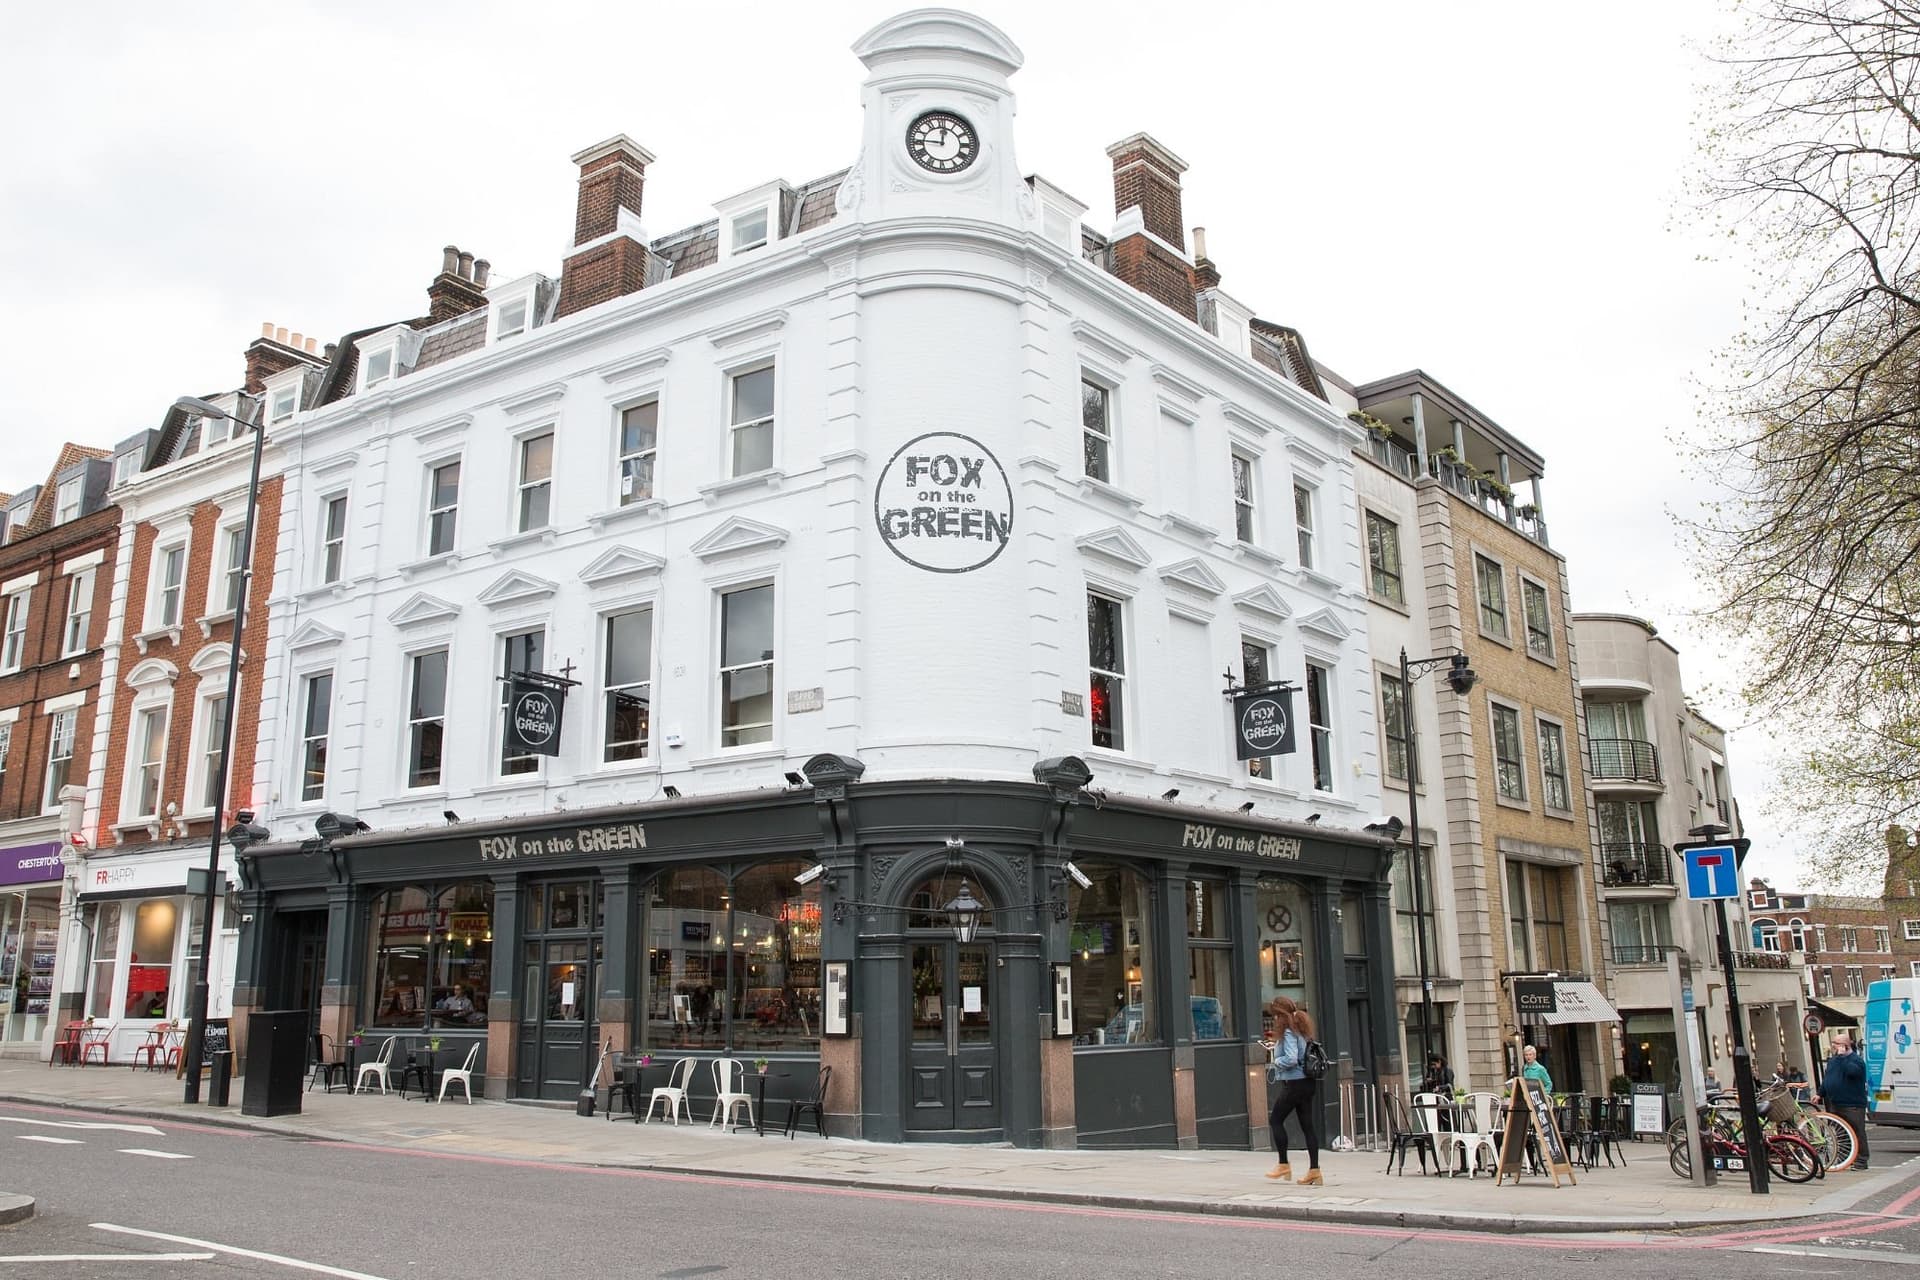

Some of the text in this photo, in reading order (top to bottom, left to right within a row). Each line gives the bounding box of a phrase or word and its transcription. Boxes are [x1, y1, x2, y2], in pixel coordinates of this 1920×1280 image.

[906, 455, 984, 488] FOX
[918, 491, 976, 503] on the
[882, 507, 1009, 544] GREEN
[525, 699, 548, 714] FOX
[1250, 707, 1275, 721] FOX
[518, 717, 553, 735] GREEN
[1245, 723, 1284, 740] GREEN
[479, 823, 647, 861] FOX on the GREEN
[1182, 824, 1302, 860] FOX on the GREEN
[18, 855, 60, 869] CHESTERTONS
[1520, 994, 1551, 1004] CÔTE
